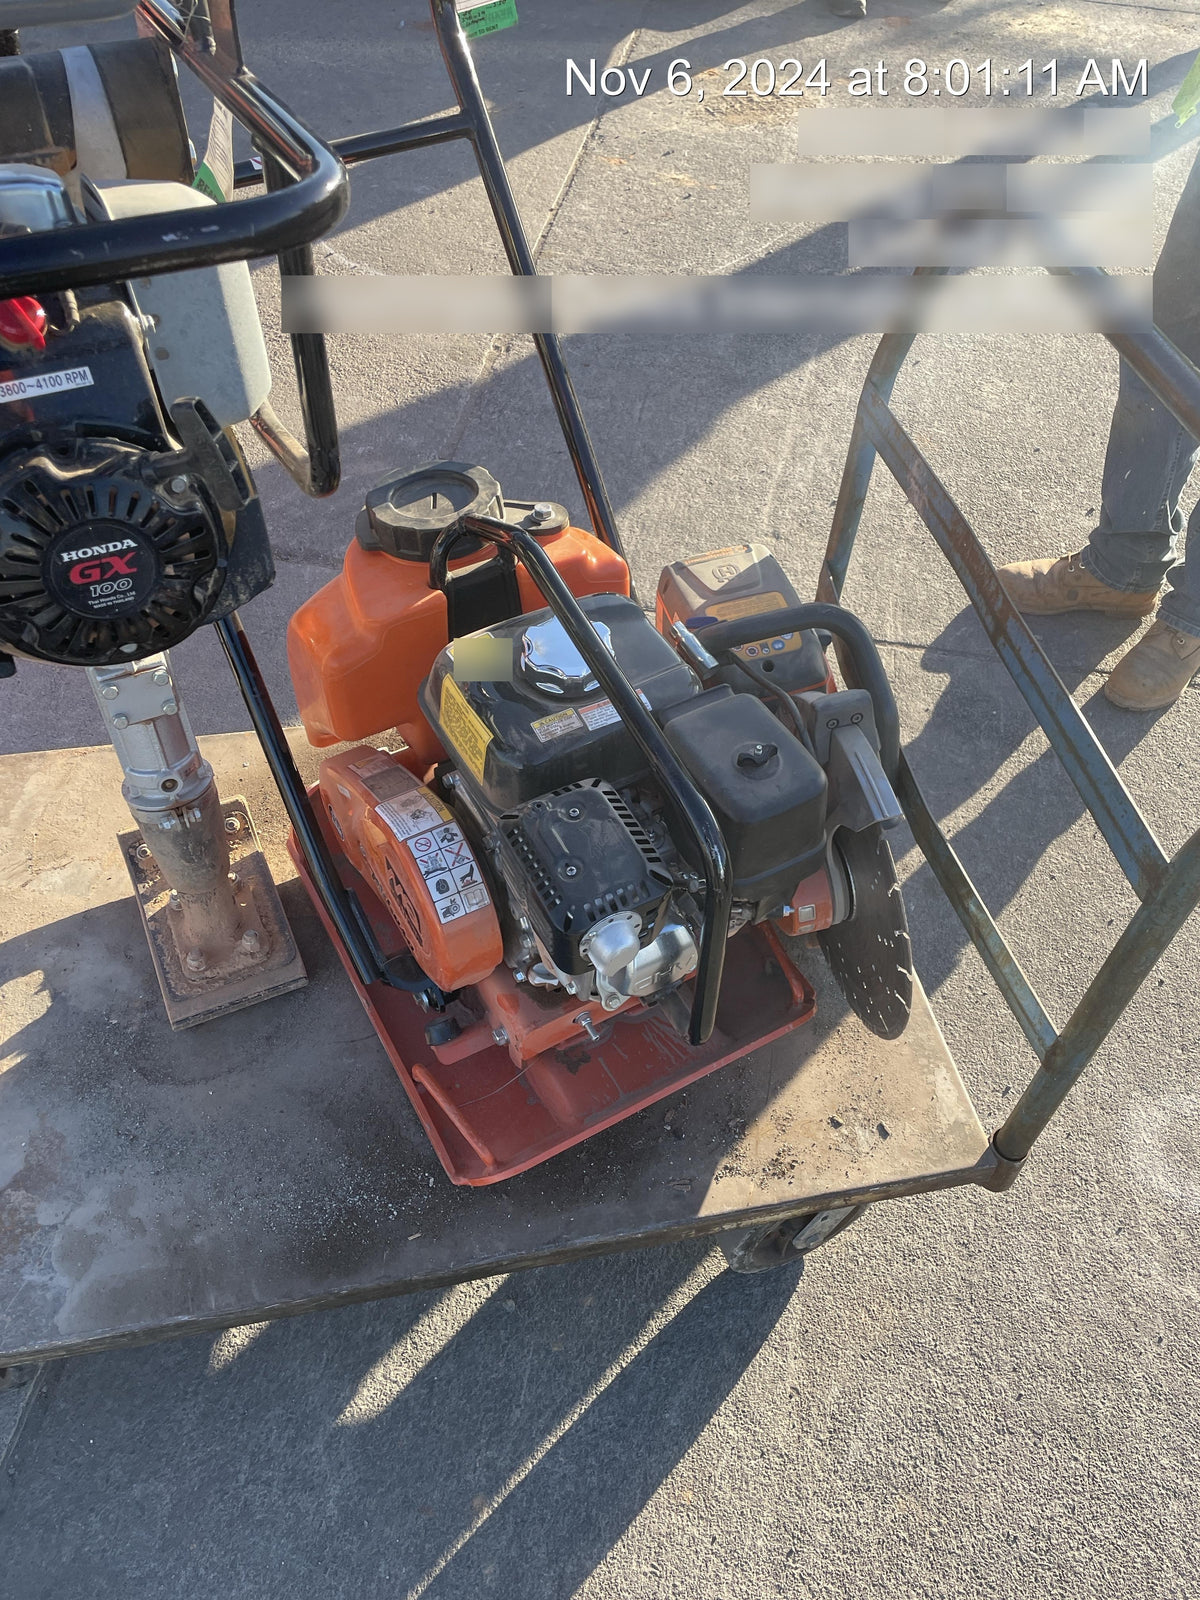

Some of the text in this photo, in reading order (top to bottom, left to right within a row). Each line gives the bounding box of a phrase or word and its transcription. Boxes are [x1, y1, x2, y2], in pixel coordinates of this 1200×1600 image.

[65, 369, 89, 384] RPM
[60, 538, 138, 562] HONDA
[69, 551, 138, 585] GX
[90, 578, 133, 597] 100
[544, 712, 569, 724] CAUTION
